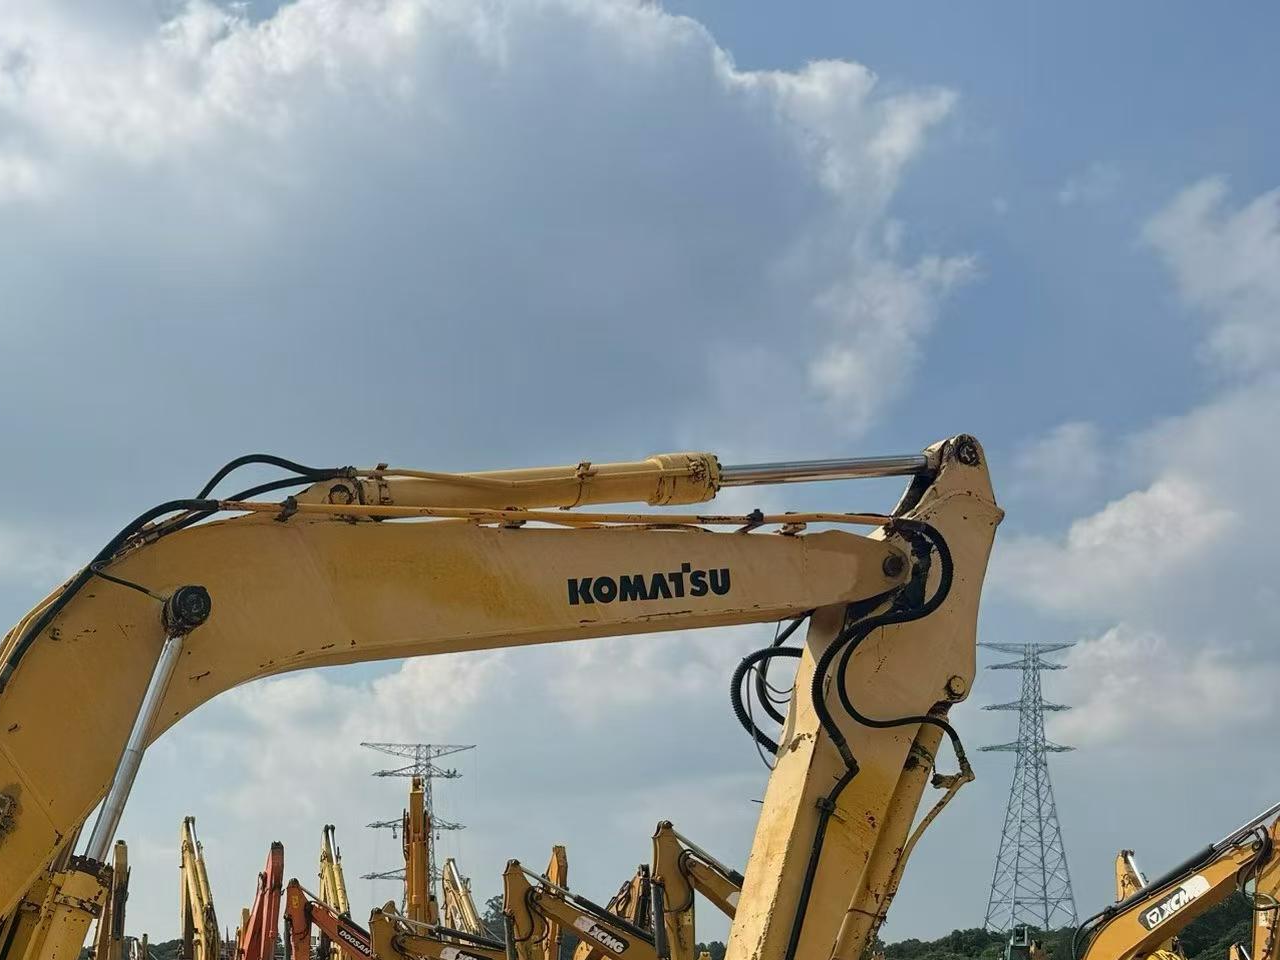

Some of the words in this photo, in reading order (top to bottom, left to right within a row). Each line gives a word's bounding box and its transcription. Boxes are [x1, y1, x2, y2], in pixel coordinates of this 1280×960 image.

[567, 563, 732, 606] KOMATSU
[339, 929, 372, 955] DOOSAN
[589, 925, 625, 953] XCMG
